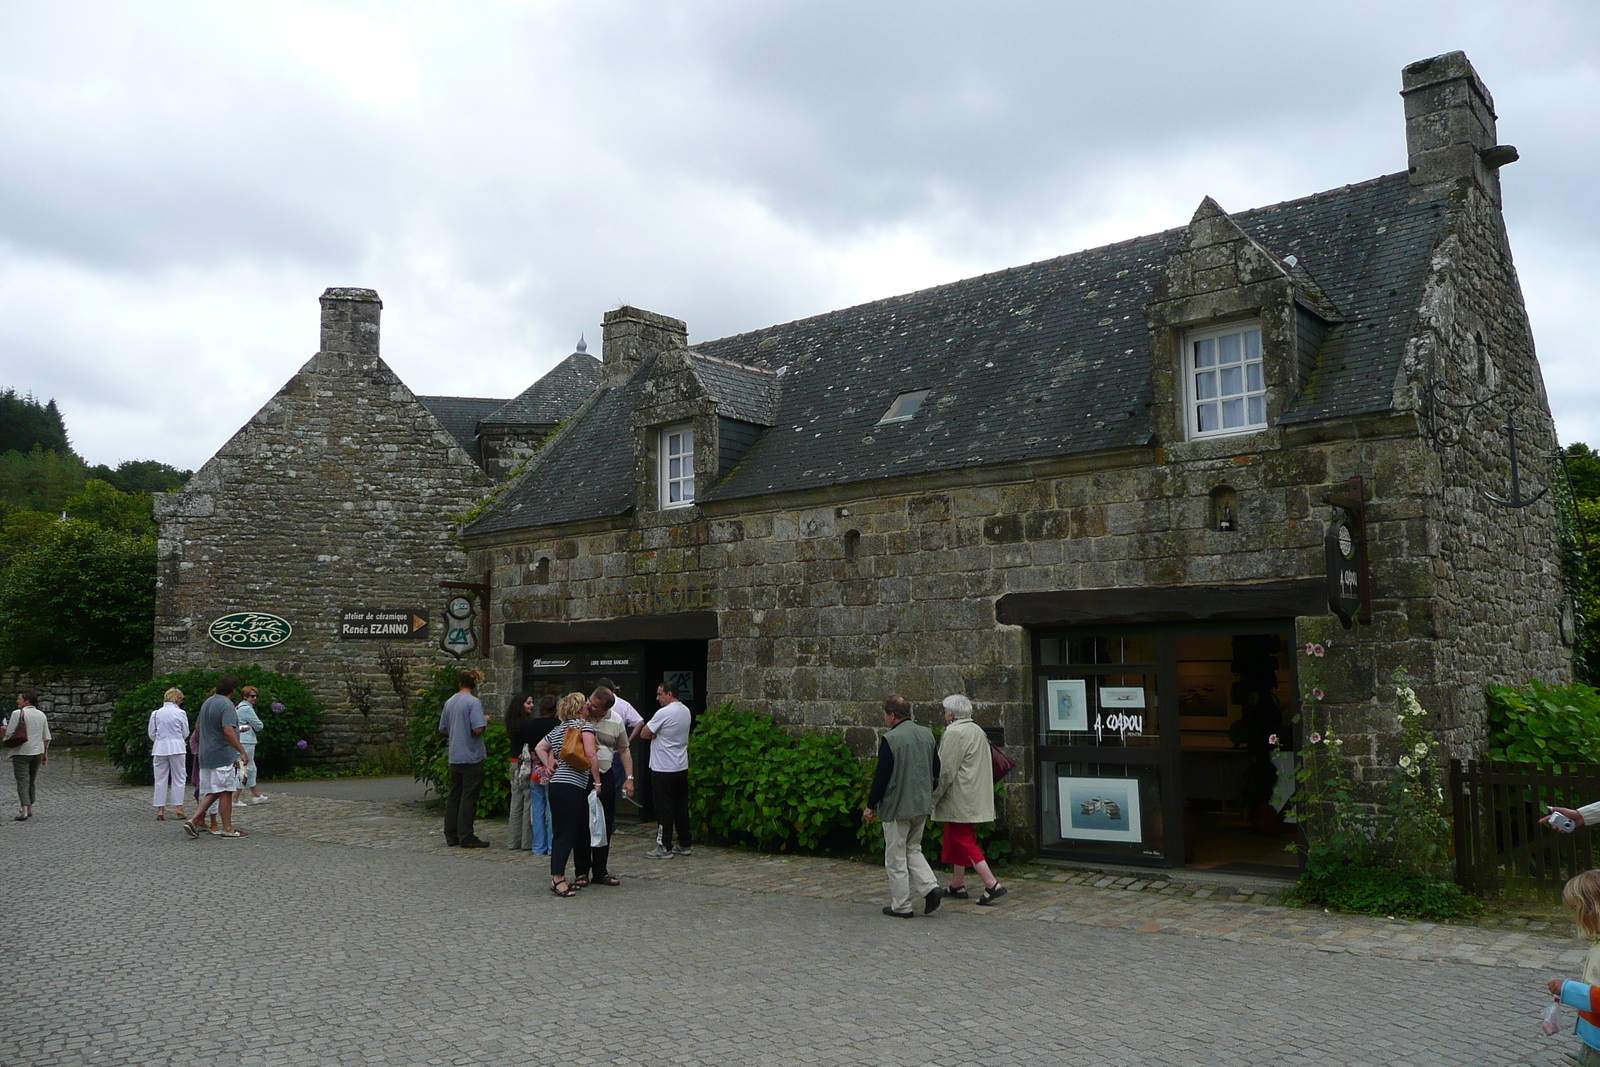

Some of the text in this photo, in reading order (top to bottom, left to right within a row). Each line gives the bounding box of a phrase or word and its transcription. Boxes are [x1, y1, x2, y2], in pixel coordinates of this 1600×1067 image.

[597, 580, 714, 614] AGRICOLE
[344, 612, 408, 622] atelier de céramique
[342, 624, 409, 635] Renée EZANNO
[220, 633, 281, 643] CO SAC
